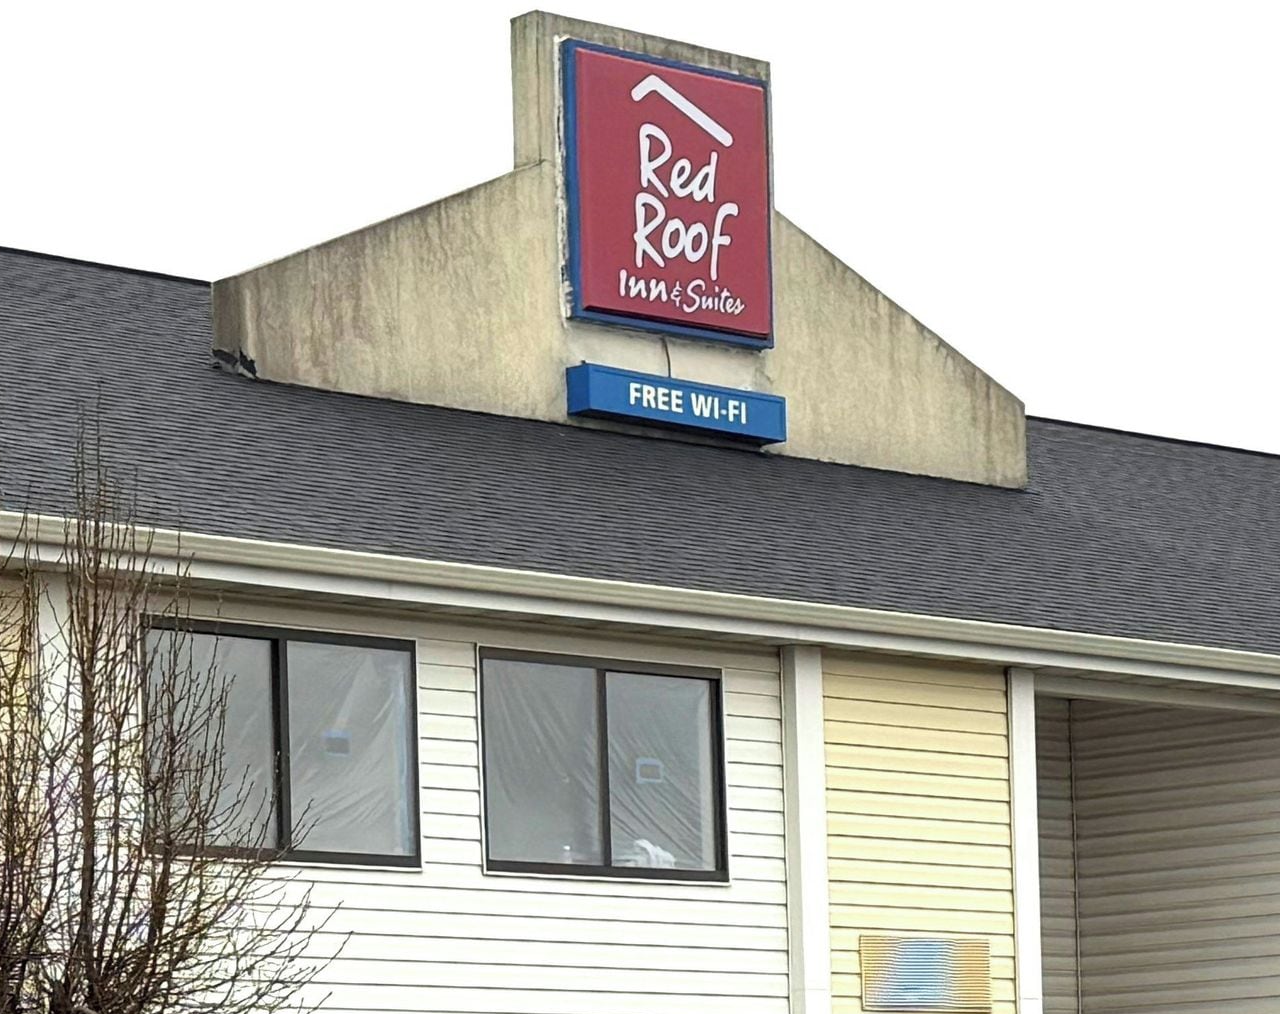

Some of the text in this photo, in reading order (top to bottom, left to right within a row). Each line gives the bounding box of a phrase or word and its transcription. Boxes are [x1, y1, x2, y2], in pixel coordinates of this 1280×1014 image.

[638, 123, 718, 202] Red
[634, 192, 739, 281] Roof
[619, 269, 745, 316] Inn & Suites
[628, 382, 747, 425] FREE WI-FI
